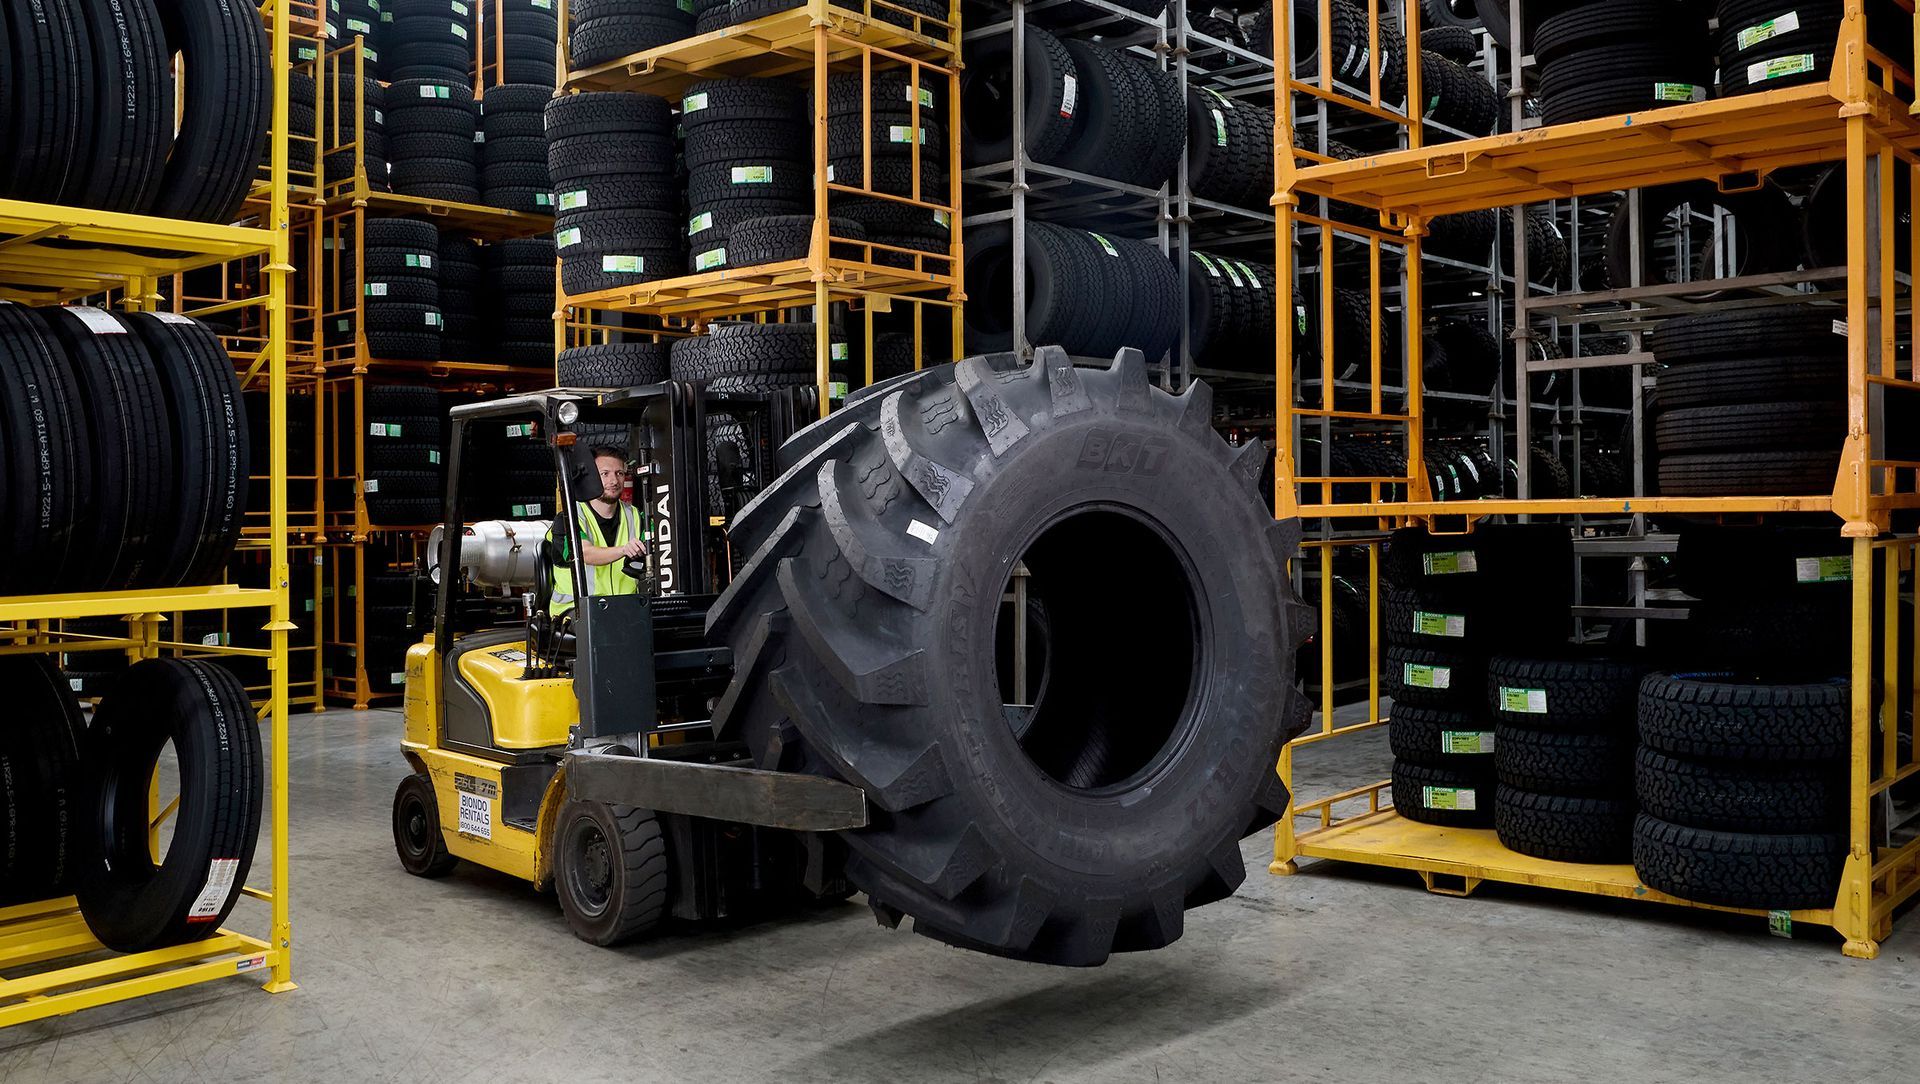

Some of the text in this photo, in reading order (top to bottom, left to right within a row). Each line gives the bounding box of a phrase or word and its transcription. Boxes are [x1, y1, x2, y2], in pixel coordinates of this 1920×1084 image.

[718, 392, 729, 400] 124
[1078, 433, 1171, 473] BKT
[461, 795, 487, 812] BIONDO
[460, 807, 490, 825] RENTALS
